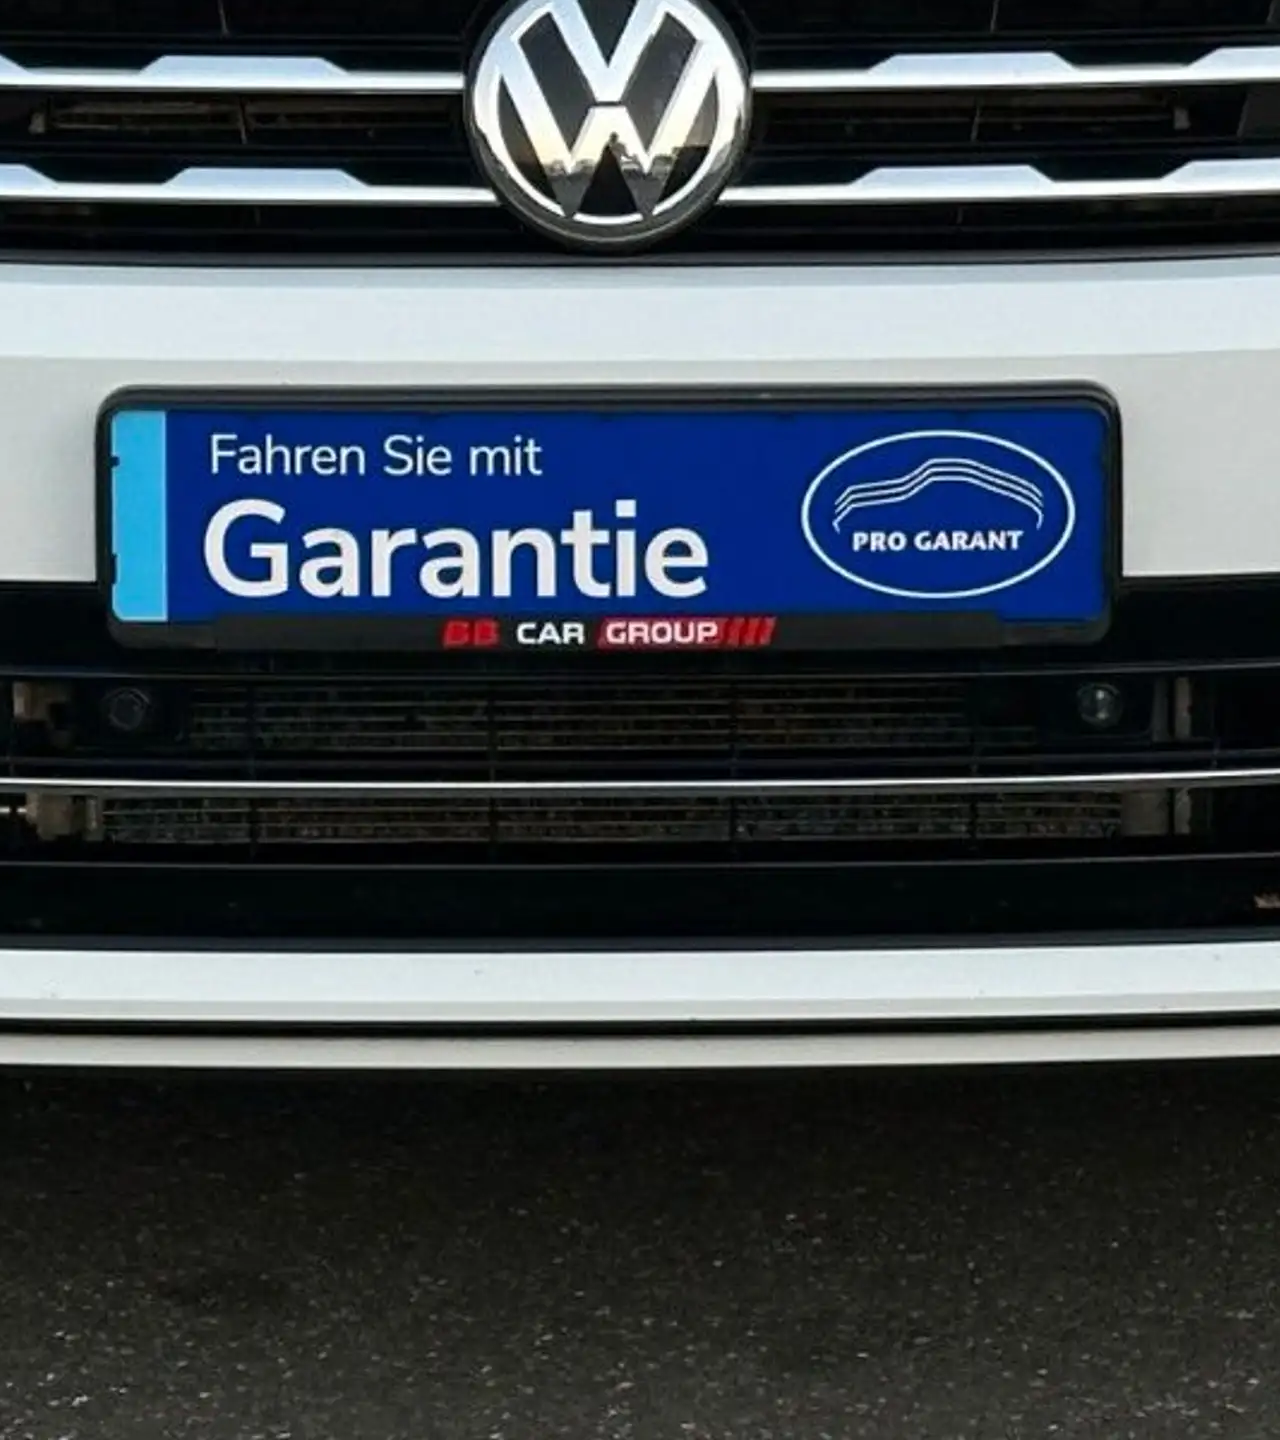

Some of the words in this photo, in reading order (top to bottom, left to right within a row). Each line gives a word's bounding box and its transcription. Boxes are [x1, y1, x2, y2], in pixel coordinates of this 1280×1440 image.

[210, 434, 365, 476] Fahren
[383, 434, 452, 477] Sie
[469, 435, 543, 477] mit
[203, 498, 709, 598] Garantie
[852, 531, 907, 552] PRO
[914, 530, 1024, 551] GARANT
[516, 621, 585, 645] CAR
[605, 620, 719, 645] GROUP
